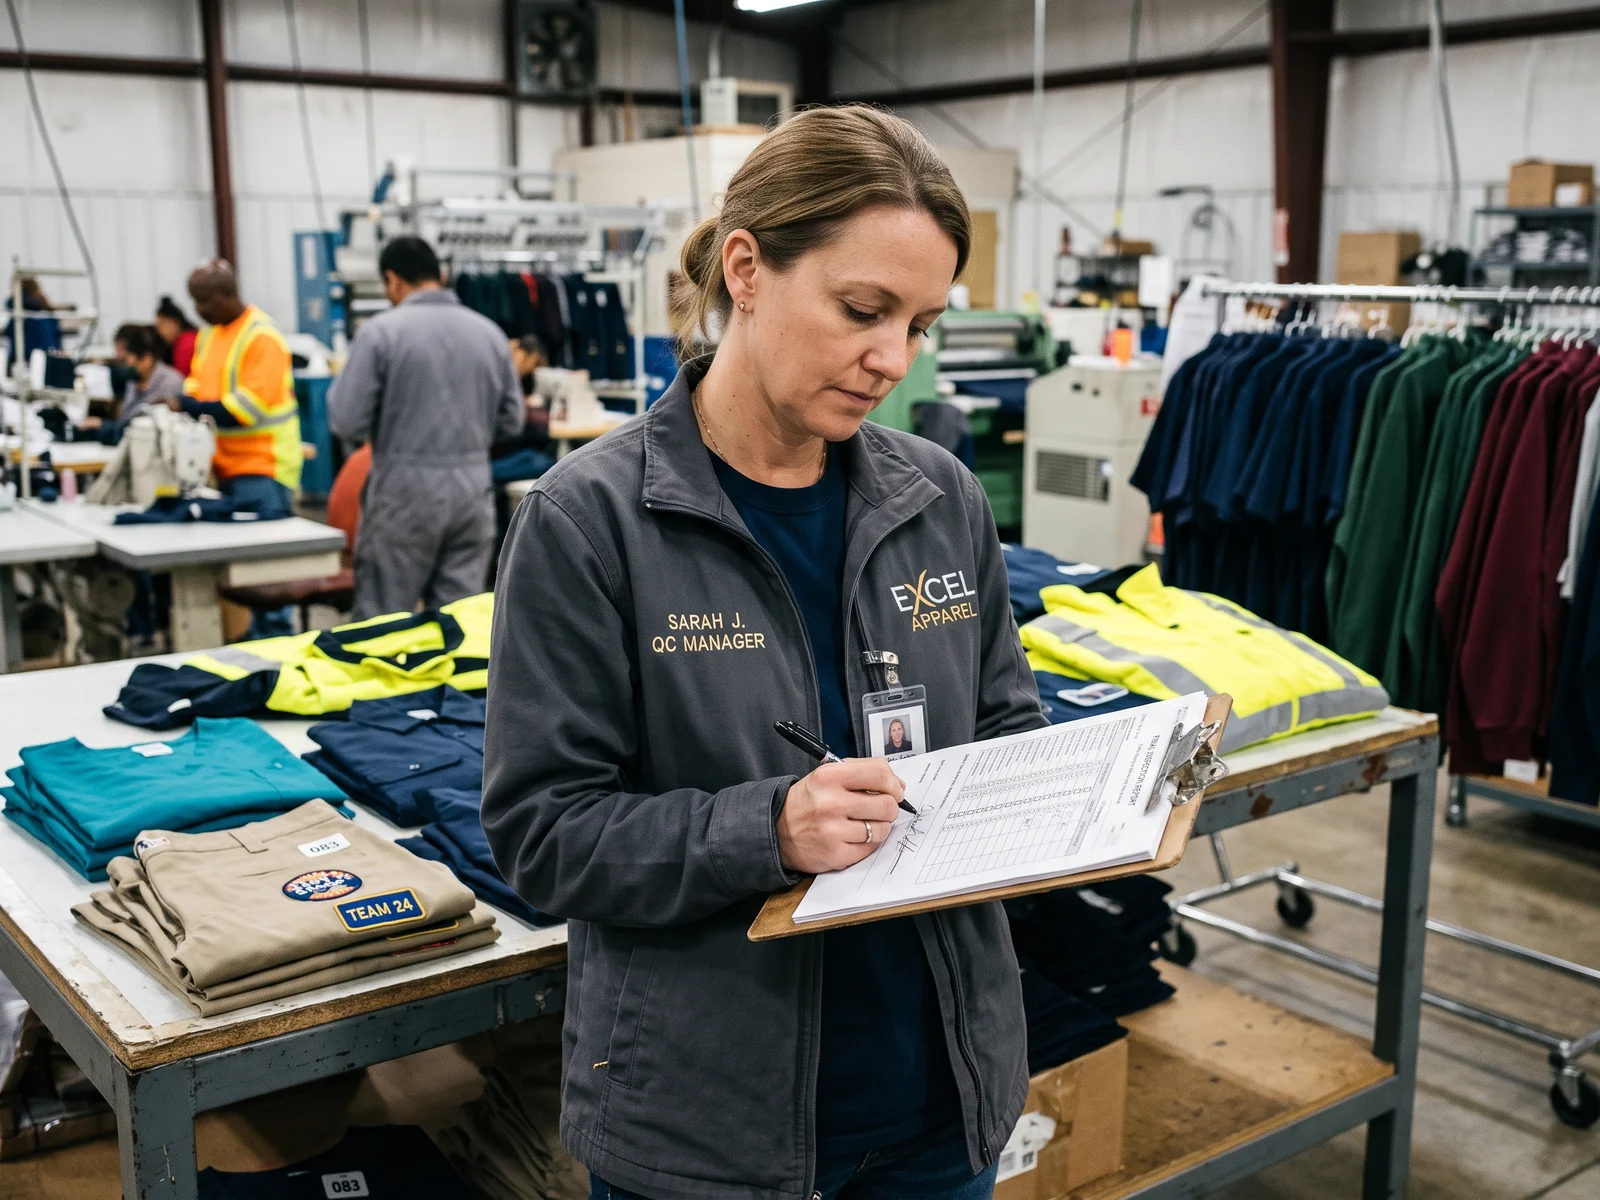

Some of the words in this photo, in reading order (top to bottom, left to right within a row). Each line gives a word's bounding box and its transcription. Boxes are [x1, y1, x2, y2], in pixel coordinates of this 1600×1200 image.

[890, 569, 976, 615] EXCEL
[668, 612, 724, 630] SARAH
[731, 612, 746, 628] J.
[912, 602, 978, 632] APPAREL
[652, 635, 677, 653] QC
[683, 633, 766, 652] MANAGER
[1135, 751, 1155, 785] INSPECTION
[1127, 784, 1143, 806] REPORT
[310, 841, 339, 853] 083
[345, 902, 392, 922] TEAM
[393, 898, 413, 913] 24
[331, 1180, 361, 1193] 083
